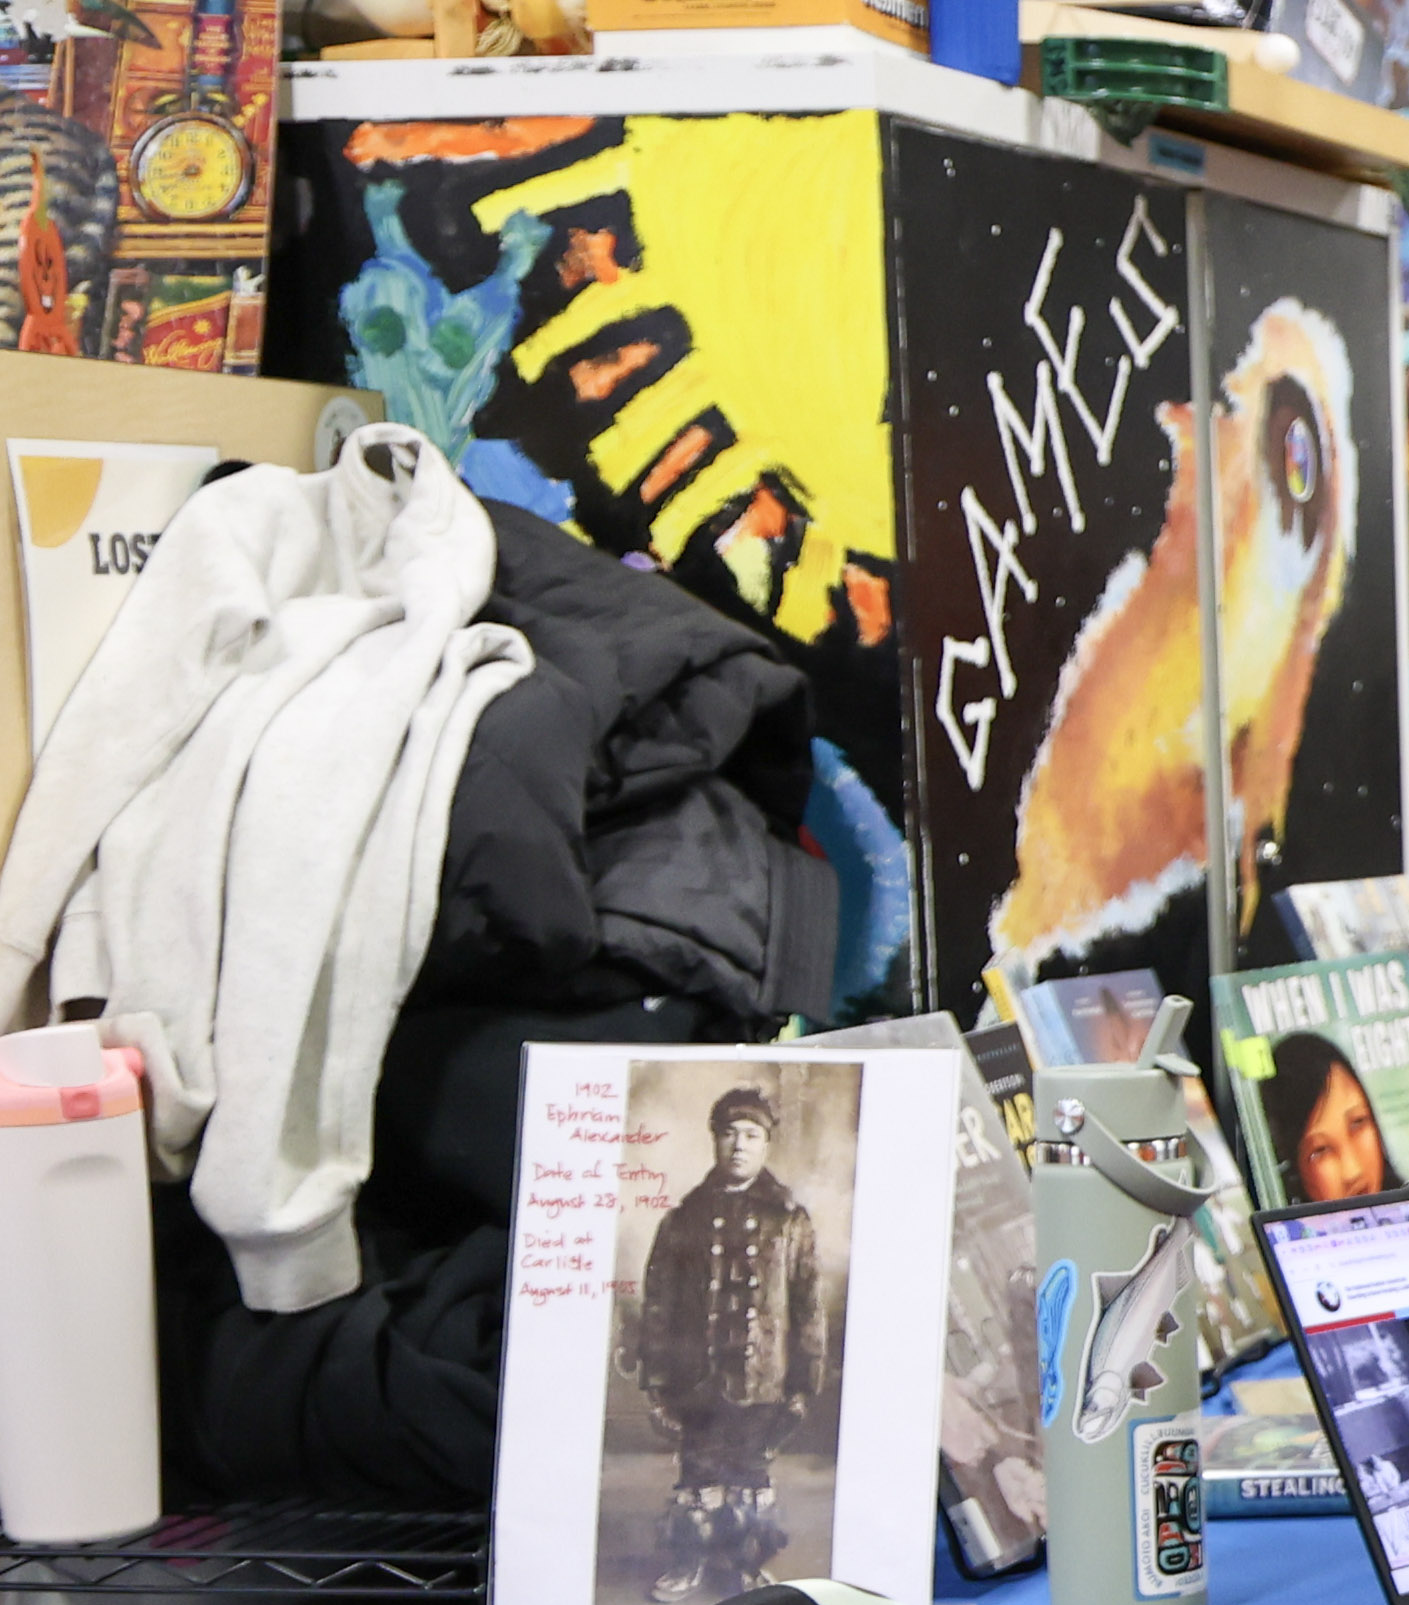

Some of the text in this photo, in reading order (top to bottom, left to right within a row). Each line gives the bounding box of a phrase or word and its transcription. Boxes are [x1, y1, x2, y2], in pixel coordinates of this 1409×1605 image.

[1241, 973, 1330, 1035] WHEN
[1328, 971, 1348, 1019] I
[575, 1082, 619, 1098] 1902
[569, 1122, 669, 1144] Alexander
[533, 1159, 667, 1195] Date of Entry
[526, 1191, 586, 1220] August
[523, 1230, 593, 1249] Died at
[518, 1280, 572, 1307] August
